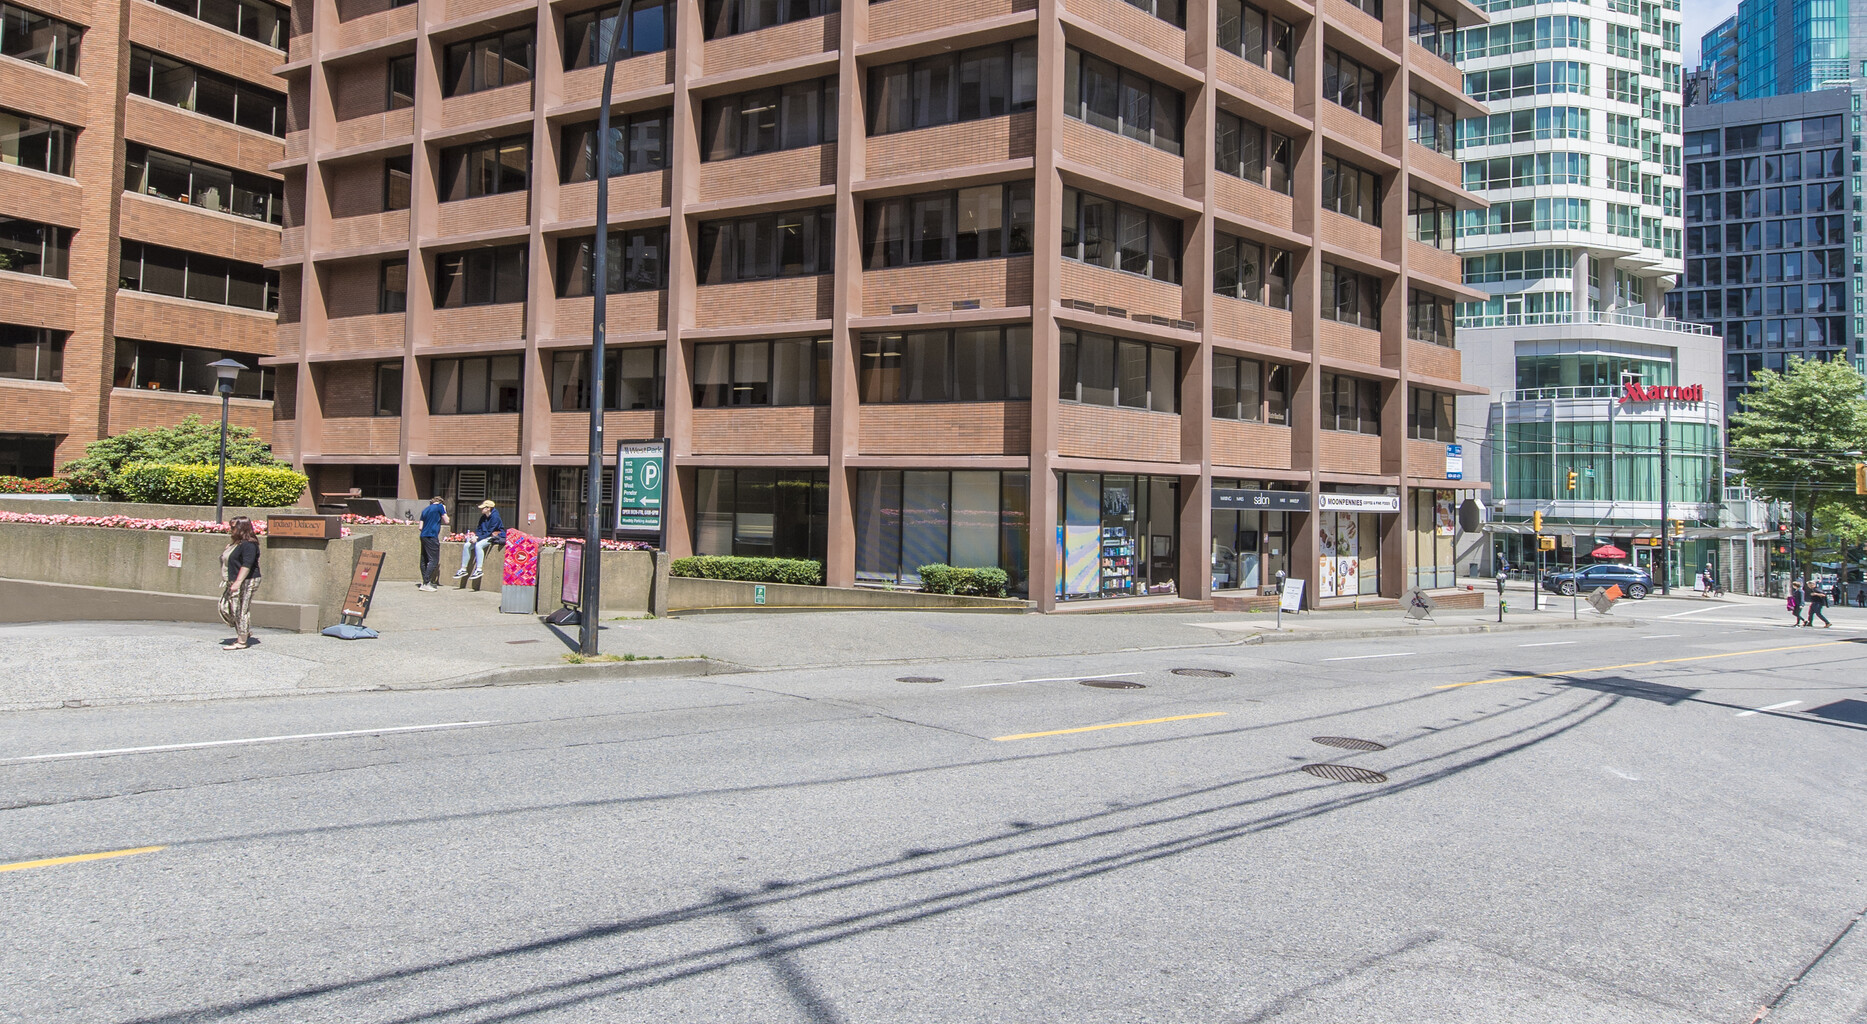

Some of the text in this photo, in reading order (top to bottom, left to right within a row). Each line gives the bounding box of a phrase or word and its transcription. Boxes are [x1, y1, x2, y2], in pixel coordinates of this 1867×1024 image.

[1618, 382, 1703, 403] Marriott
[630, 446, 662, 454] WestPark
[645, 465, 657, 485] P
[1253, 492, 1270, 505] salon
[1327, 498, 1363, 506] MOONPENNIES
[273, 520, 321, 529] Indian Delicacy
